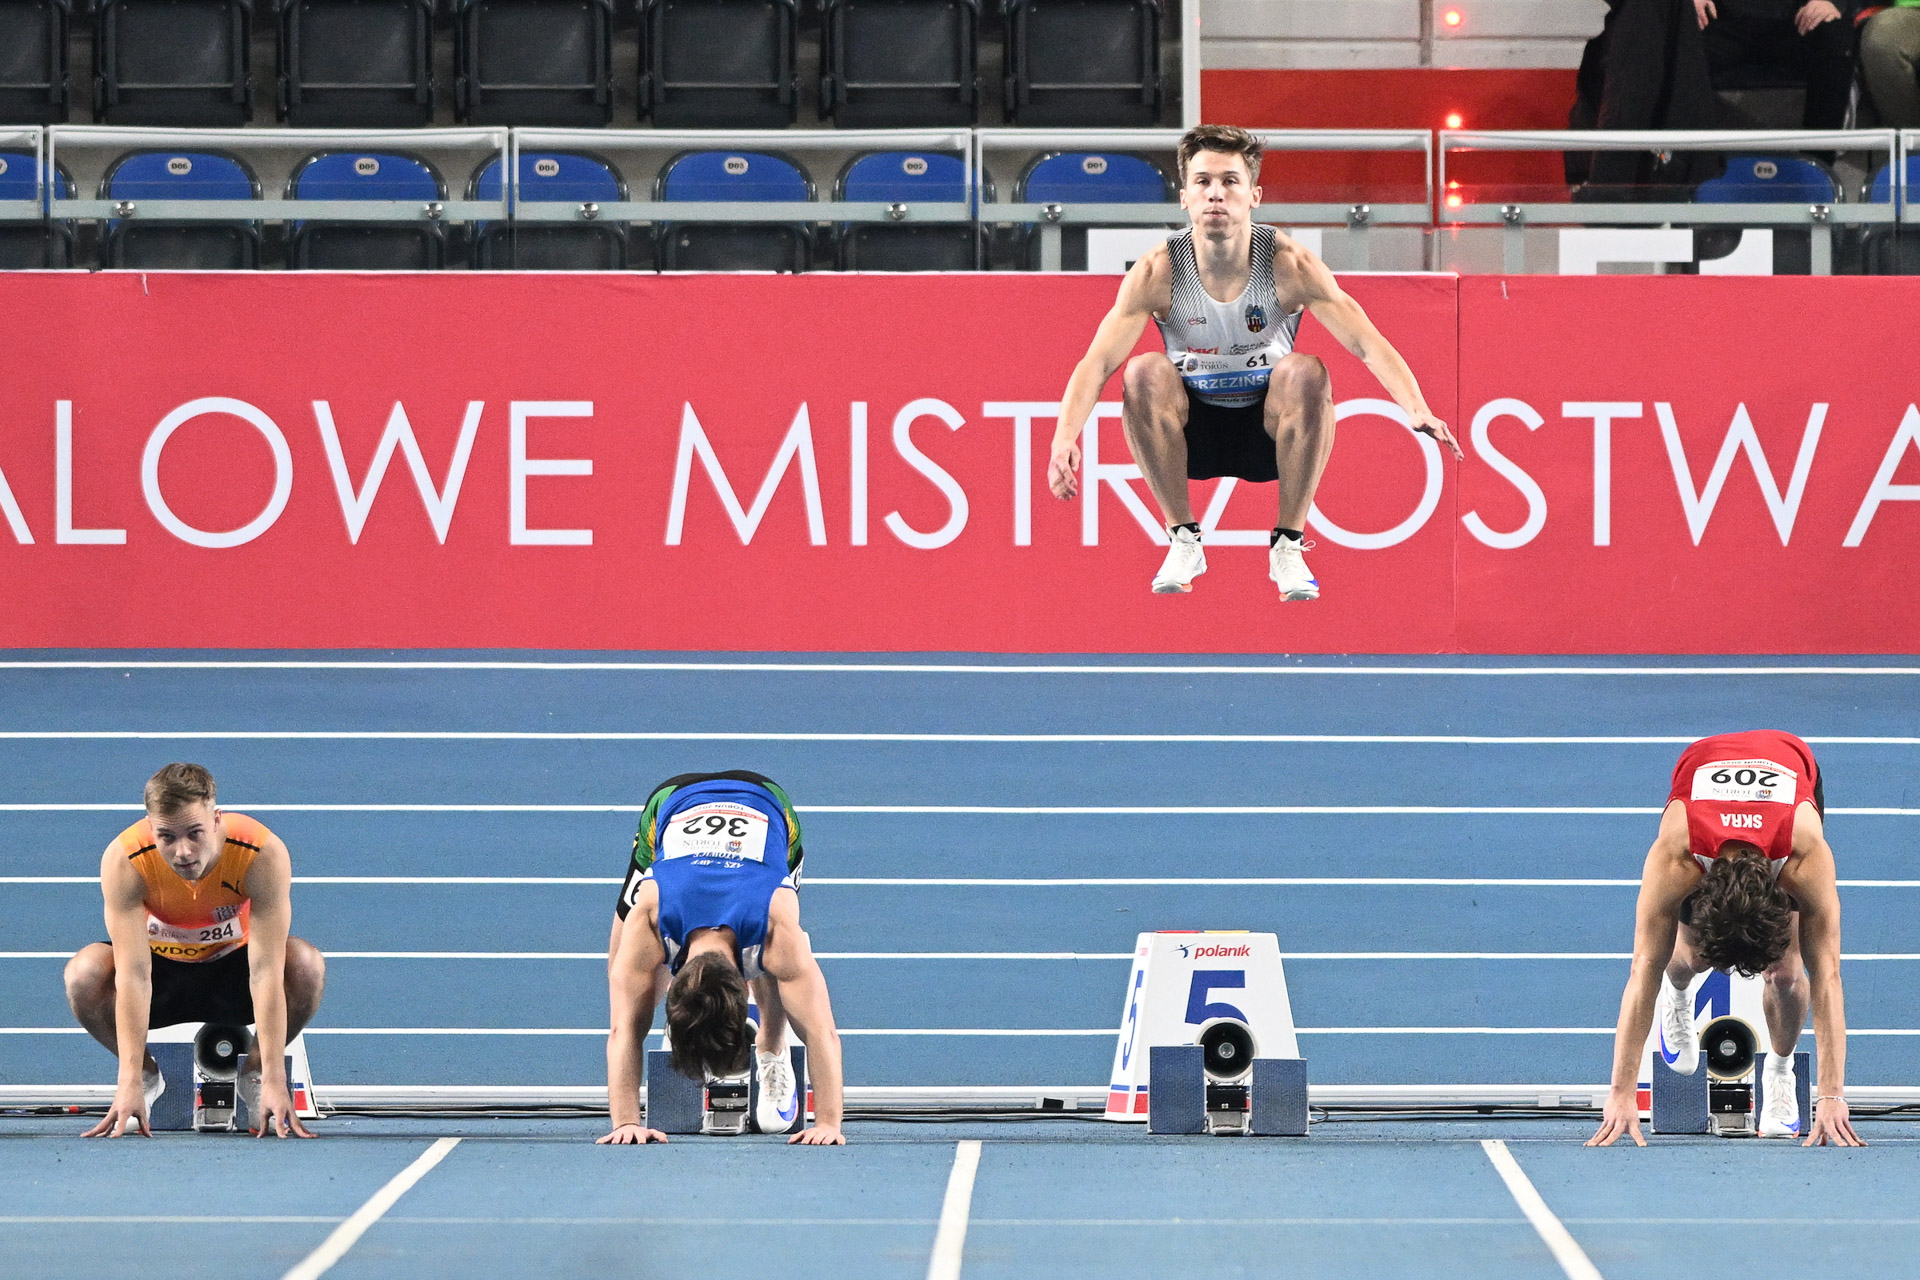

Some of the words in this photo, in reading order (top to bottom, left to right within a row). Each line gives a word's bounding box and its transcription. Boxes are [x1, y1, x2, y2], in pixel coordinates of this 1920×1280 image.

[1246, 353, 1270, 368] 61
[1188, 373, 1270, 390] BRZEZIŃS
[1711, 768, 1780, 787] 209
[682, 815, 750, 838] 362
[1720, 813, 1763, 829] SKRA
[723, 861, 745, 869] AZS
[200, 922, 234, 942] 284
[149, 944, 207, 957] WDO
[1194, 944, 1252, 960] polanik
[1184, 969, 1251, 1046] 5
